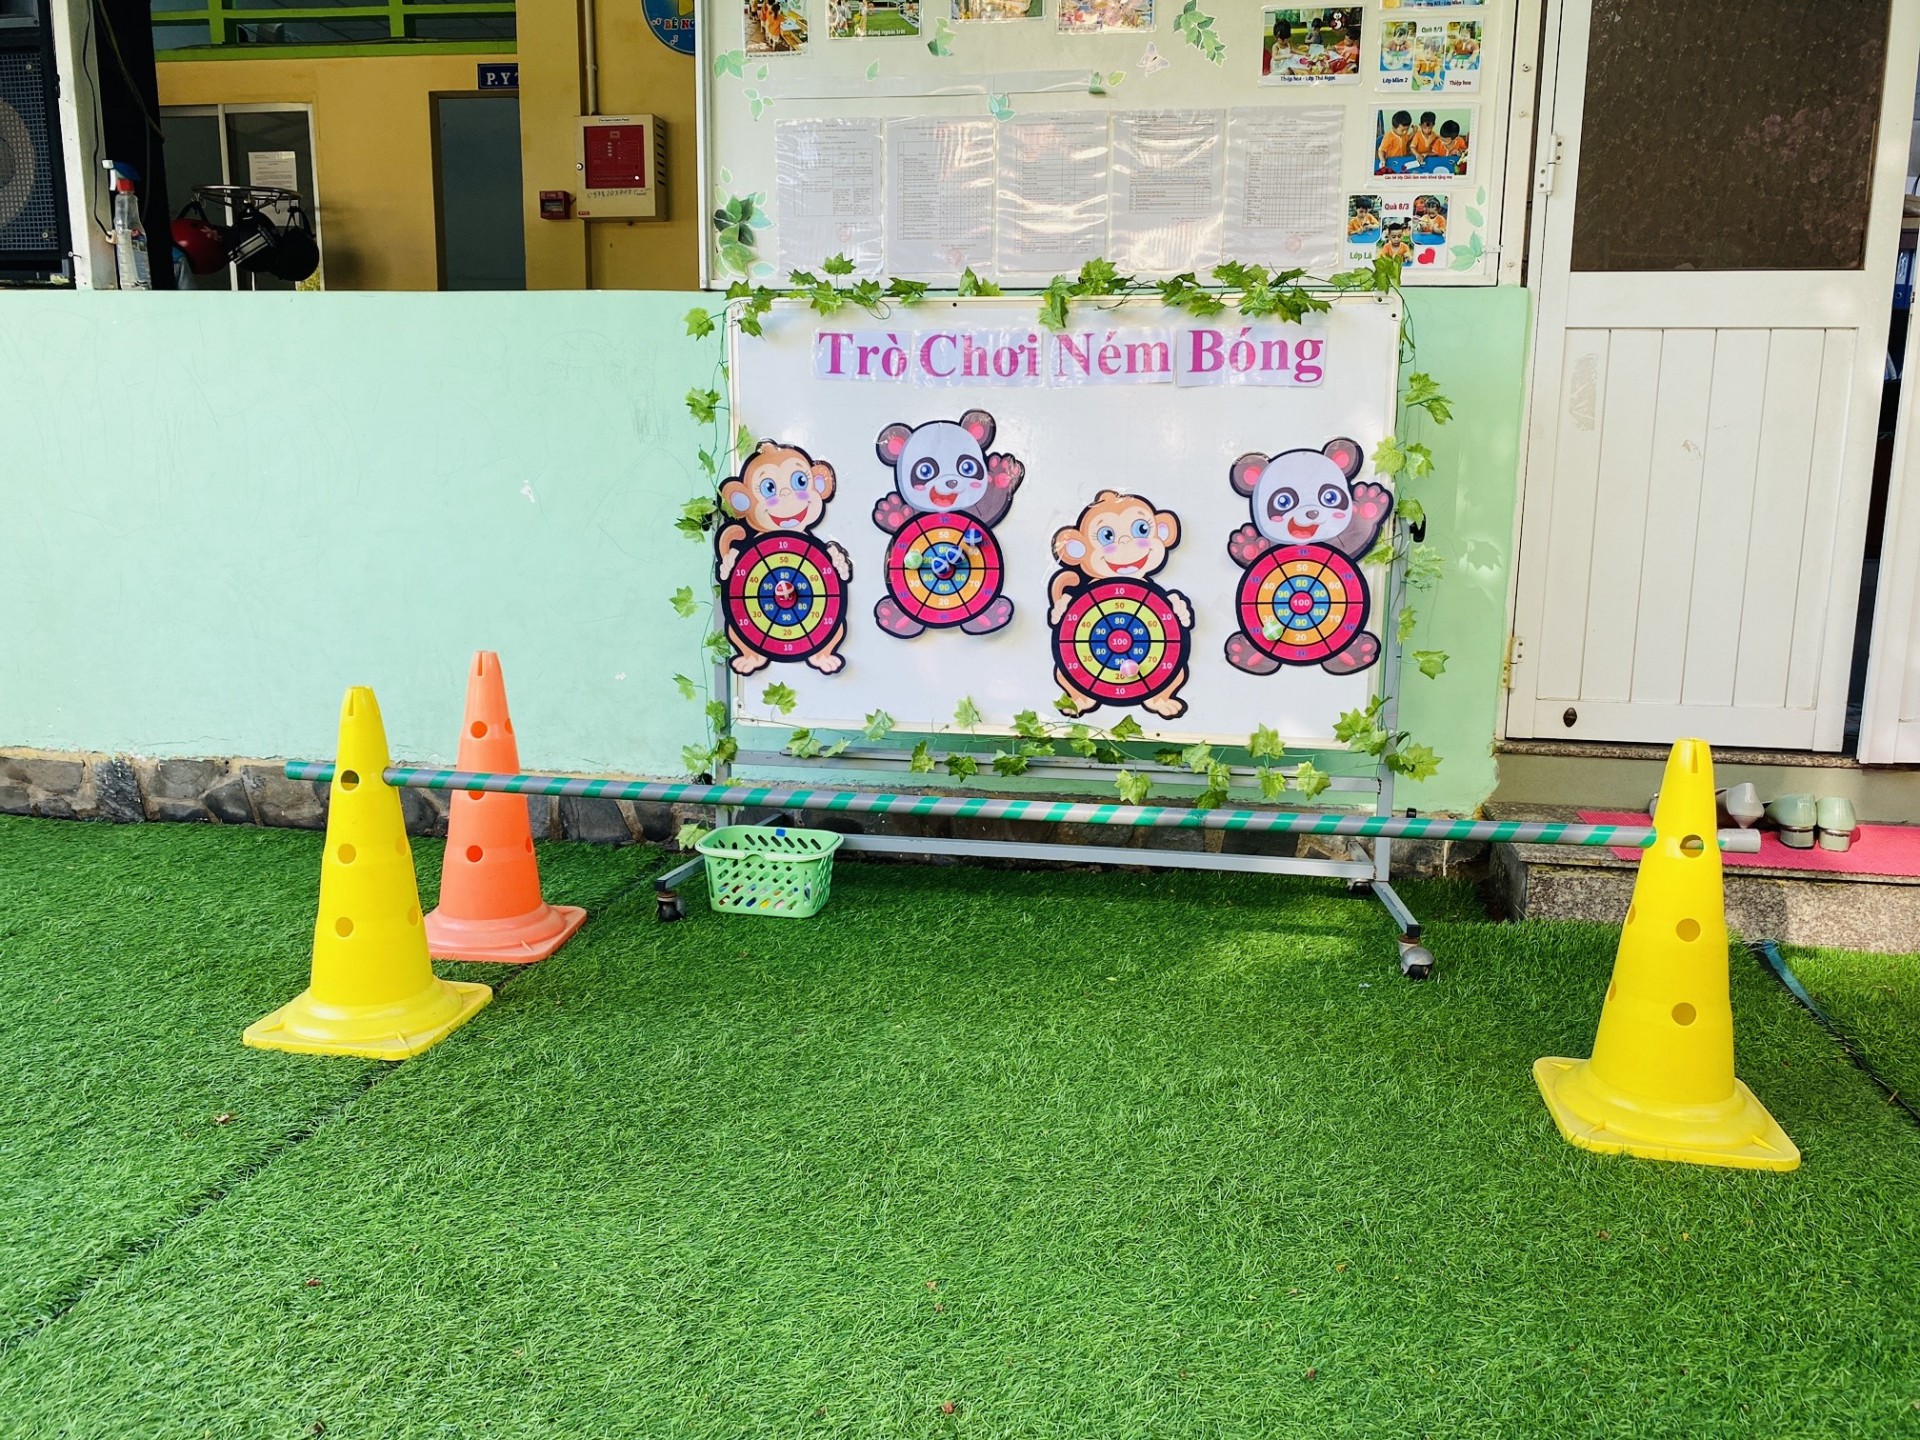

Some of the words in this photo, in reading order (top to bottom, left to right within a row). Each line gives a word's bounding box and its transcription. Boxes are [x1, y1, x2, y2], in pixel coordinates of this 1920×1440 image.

[1350, 252, 1362, 260] Lớp
[818, 332, 908, 377] Trò
[920, 333, 1040, 378] Chơi
[1054, 331, 1172, 376] Ném
[1187, 327, 1324, 382] Bóng
